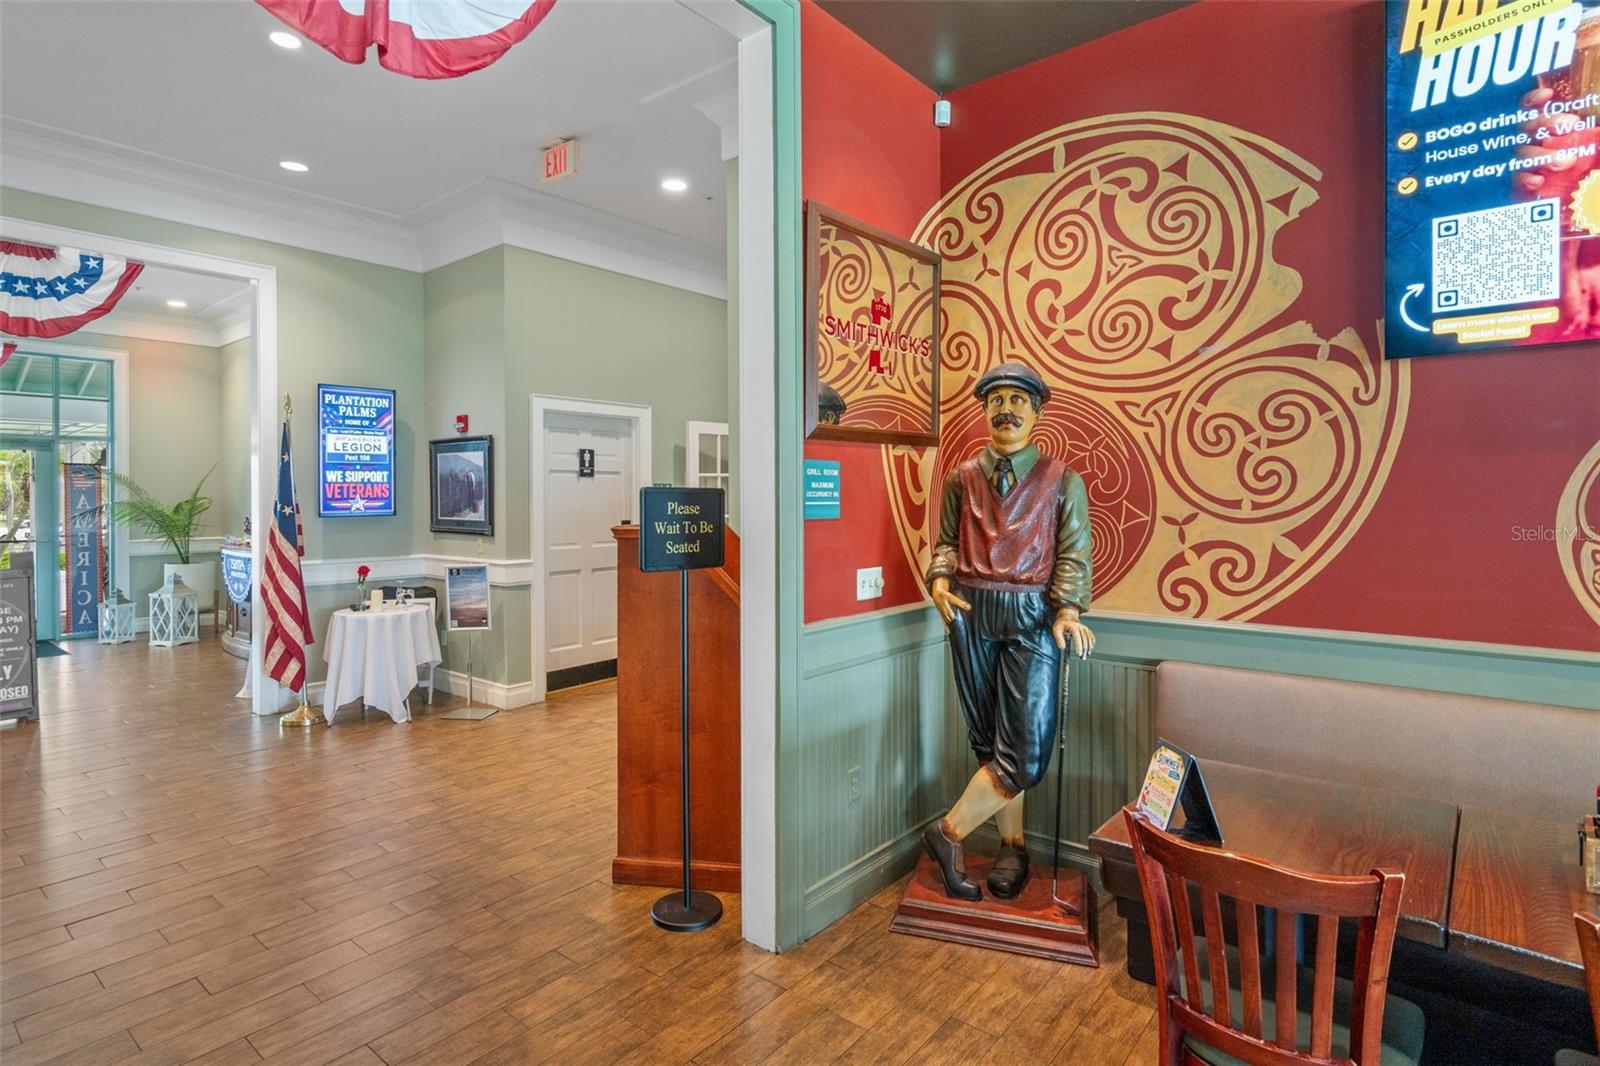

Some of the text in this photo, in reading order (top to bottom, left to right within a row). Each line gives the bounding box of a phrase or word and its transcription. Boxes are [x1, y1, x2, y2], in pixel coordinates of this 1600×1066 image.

[1434, 0, 1554, 46] PASSHOLDERS ONL
[1410, 2, 1583, 113] HOUR
[1424, 93, 1599, 144] BOGO drinks (Draft
[1425, 115, 1596, 164] House Wine, & Well
[545, 144, 568, 178] EXIT
[1424, 143, 1596, 189] Every day from 8PM
[1436, 312, 1553, 330] Learn more about our
[824, 315, 930, 358] SMITHWICK'S
[1462, 325, 1527, 340] Social Pass!
[324, 393, 390, 408] PLANTATION
[338, 405, 377, 418] PALMS
[345, 419, 361, 428] HOME
[333, 442, 382, 453] LEGION
[325, 470, 389, 483] WE SUPPORT
[806, 467, 838, 477] GRILL ROOM
[324, 483, 390, 499] VETERANS
[811, 481, 835, 489] MAXIMUM
[806, 490, 832, 498] OCCUPANCY
[667, 501, 700, 515] Please
[654, 520, 714, 535] Wait To Be
[665, 540, 700, 554] Seated
[6, 615, 23, 624] PM
